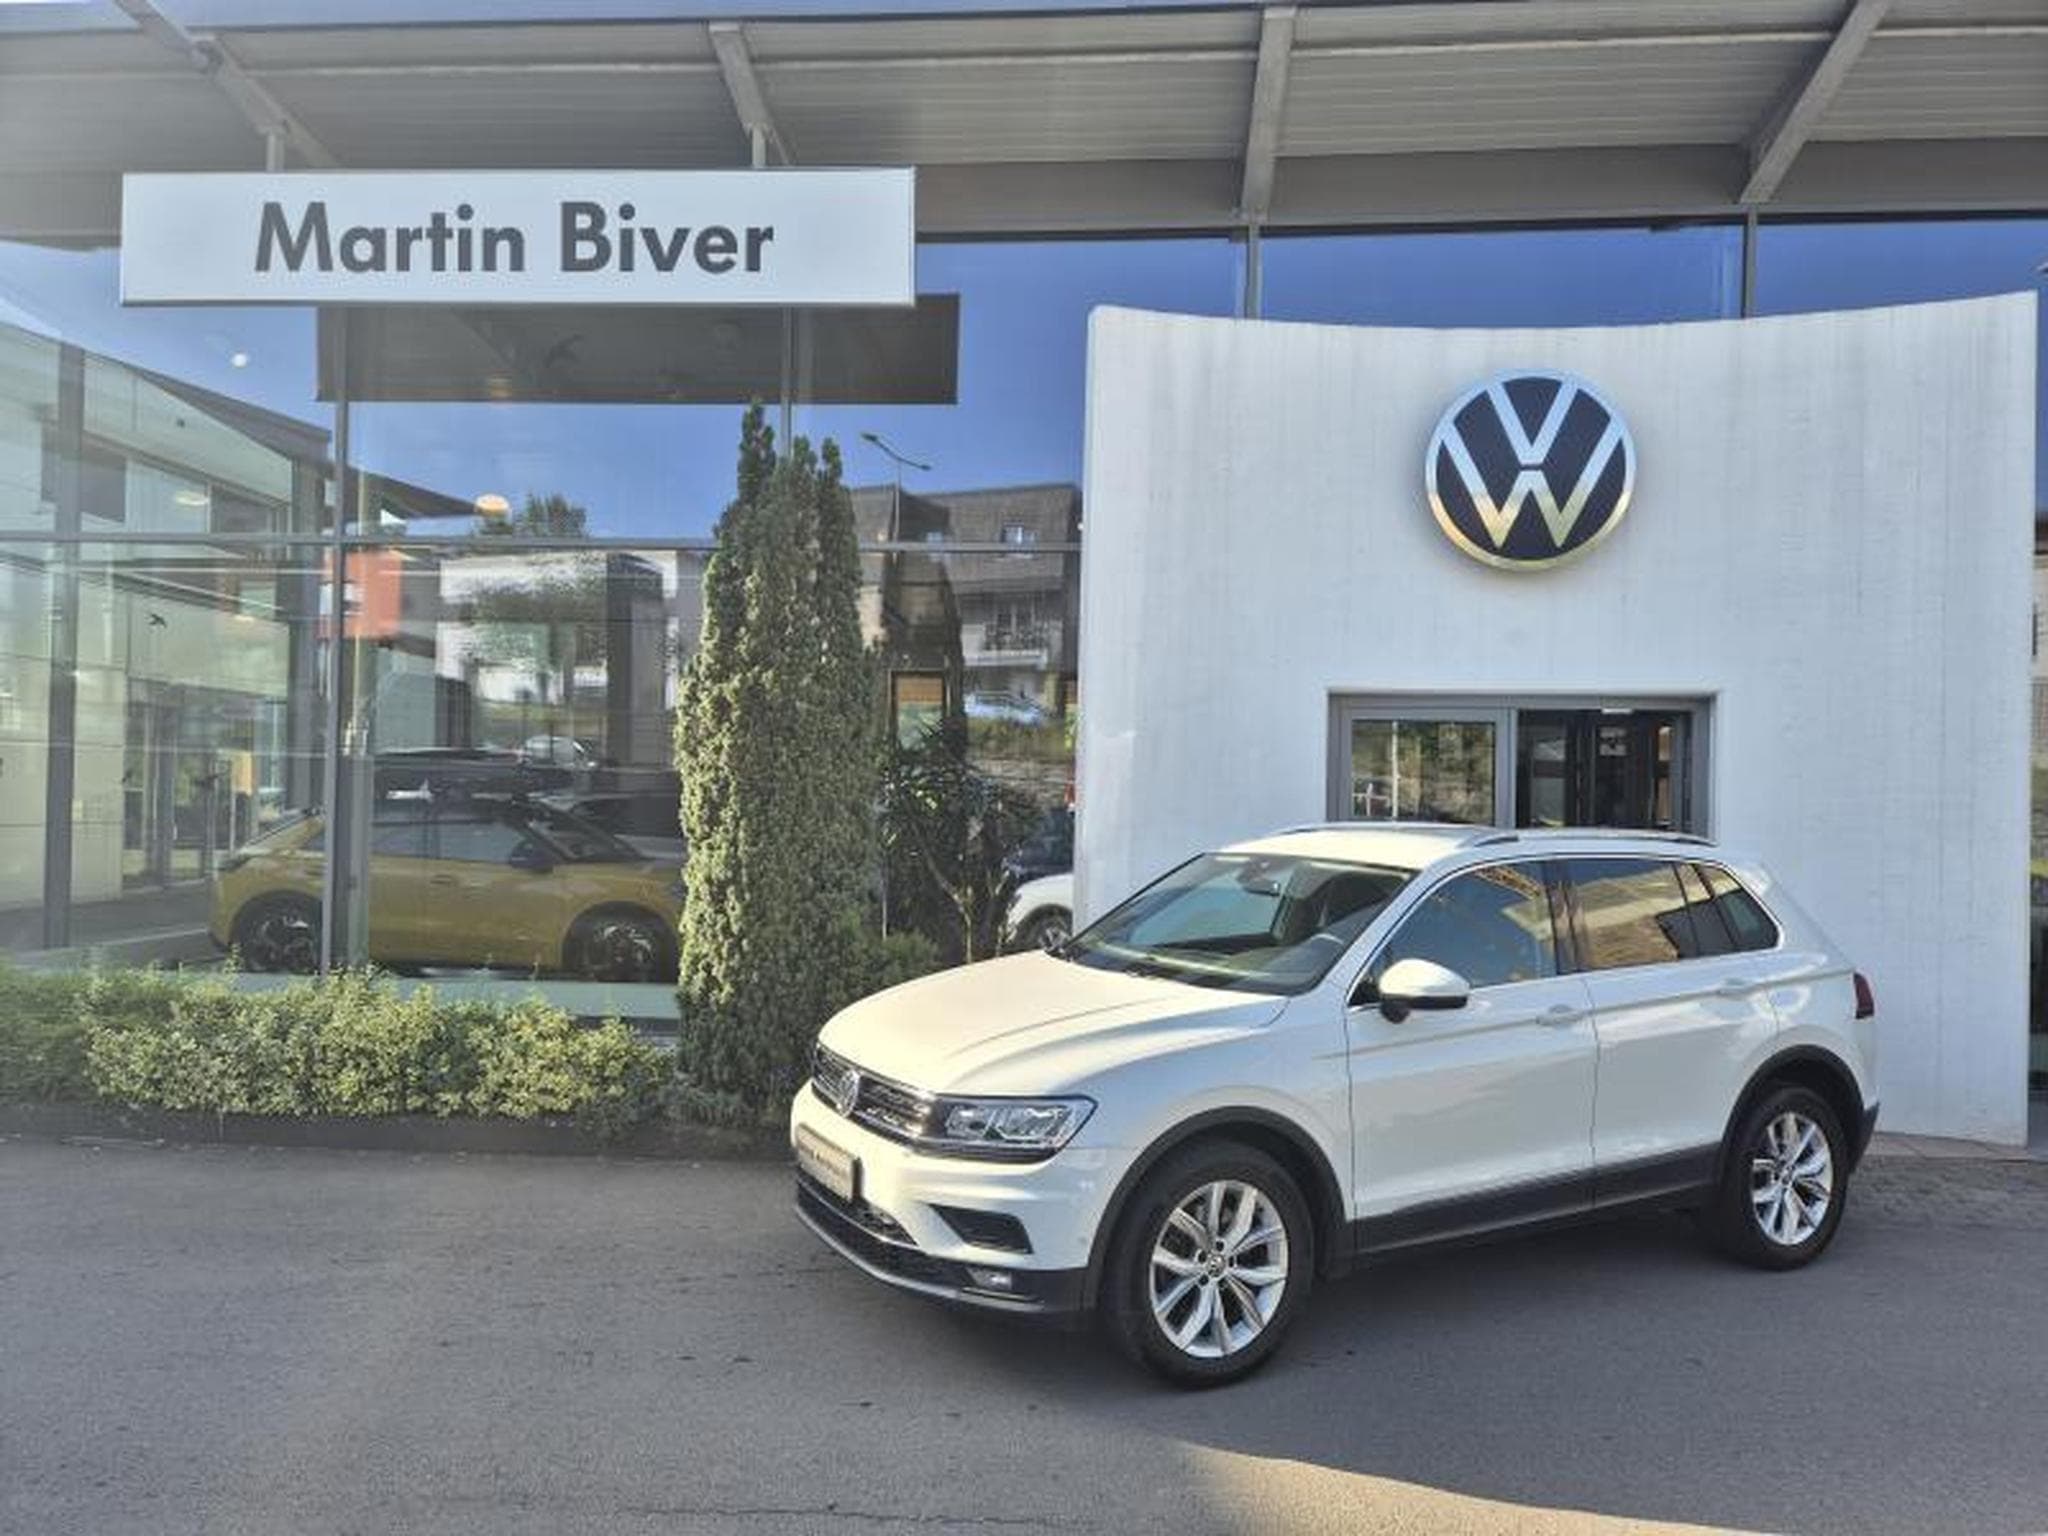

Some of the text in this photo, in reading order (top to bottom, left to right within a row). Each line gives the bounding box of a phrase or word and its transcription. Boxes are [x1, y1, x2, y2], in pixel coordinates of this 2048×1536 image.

[255, 201, 774, 274] Martin Biver
[1437, 375, 1628, 550] VW
